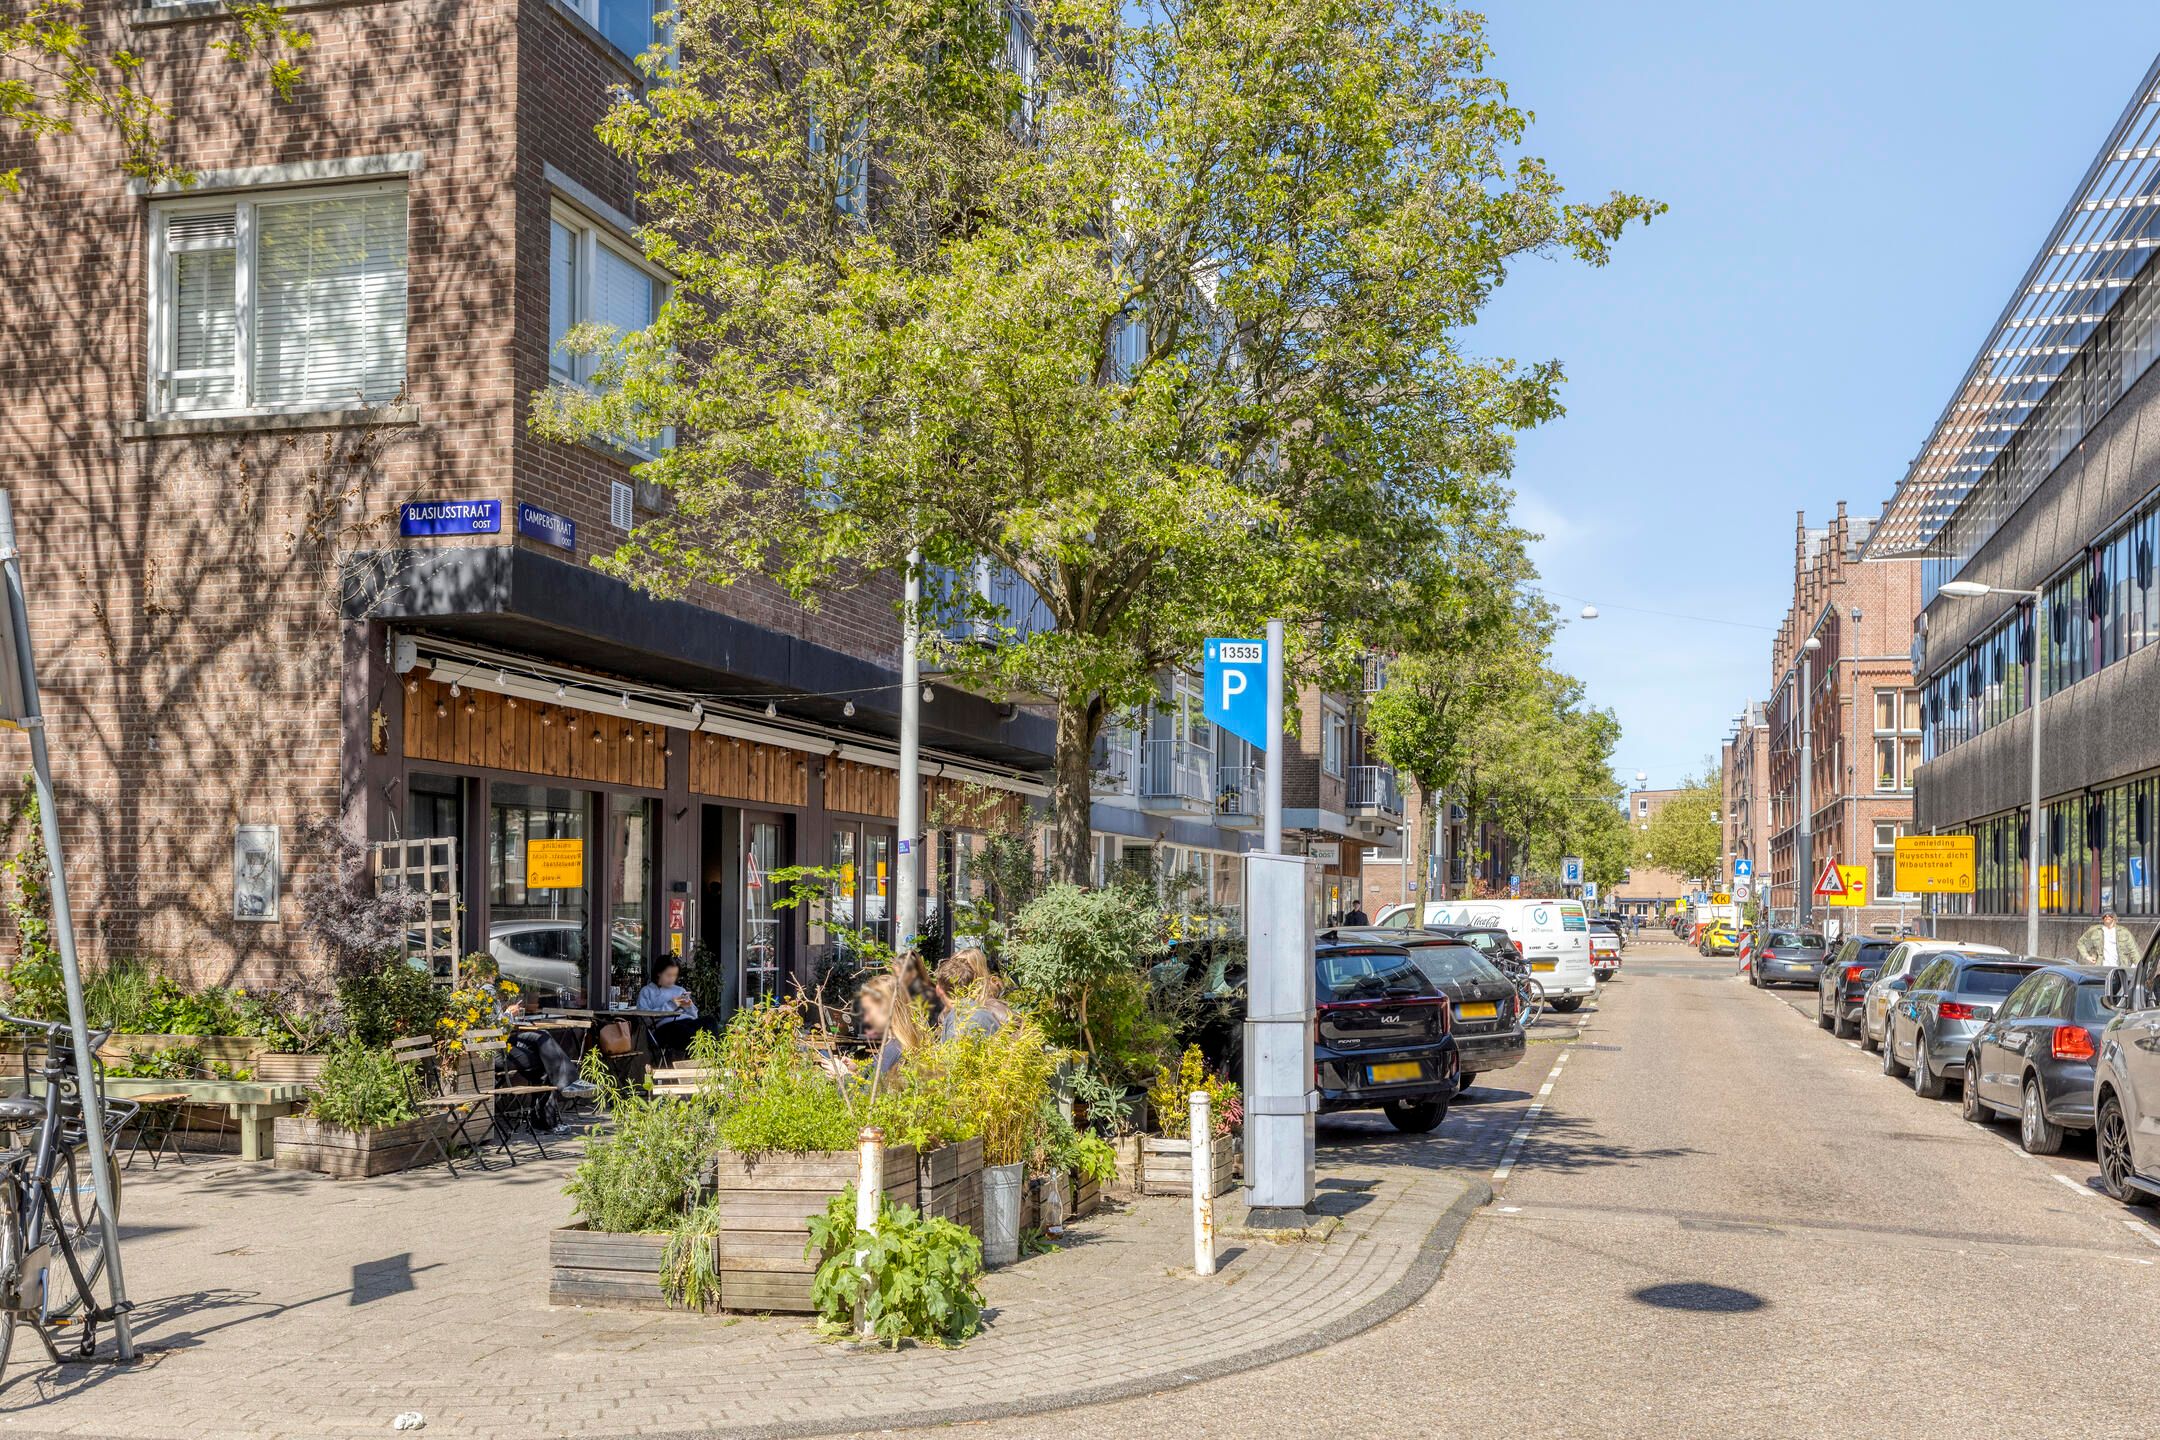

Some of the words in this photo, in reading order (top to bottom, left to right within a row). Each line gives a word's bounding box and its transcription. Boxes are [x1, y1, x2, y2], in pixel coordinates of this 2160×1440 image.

[409, 504, 492, 521] BLASIUSSTRAAT
[472, 520, 491, 529] OOST
[524, 508, 572, 535] CAMPERSTRAAT
[561, 537, 572, 547] OOST
[1221, 646, 1259, 659] 13535
[1222, 669, 1248, 710] P
[1913, 840, 1955, 848] omleiding
[1899, 852, 1945, 860] Ruyschstr.
[1569, 865, 1576, 874] P
[1936, 877, 1954, 885] volg
[1380, 1015, 1400, 1023] KIA
